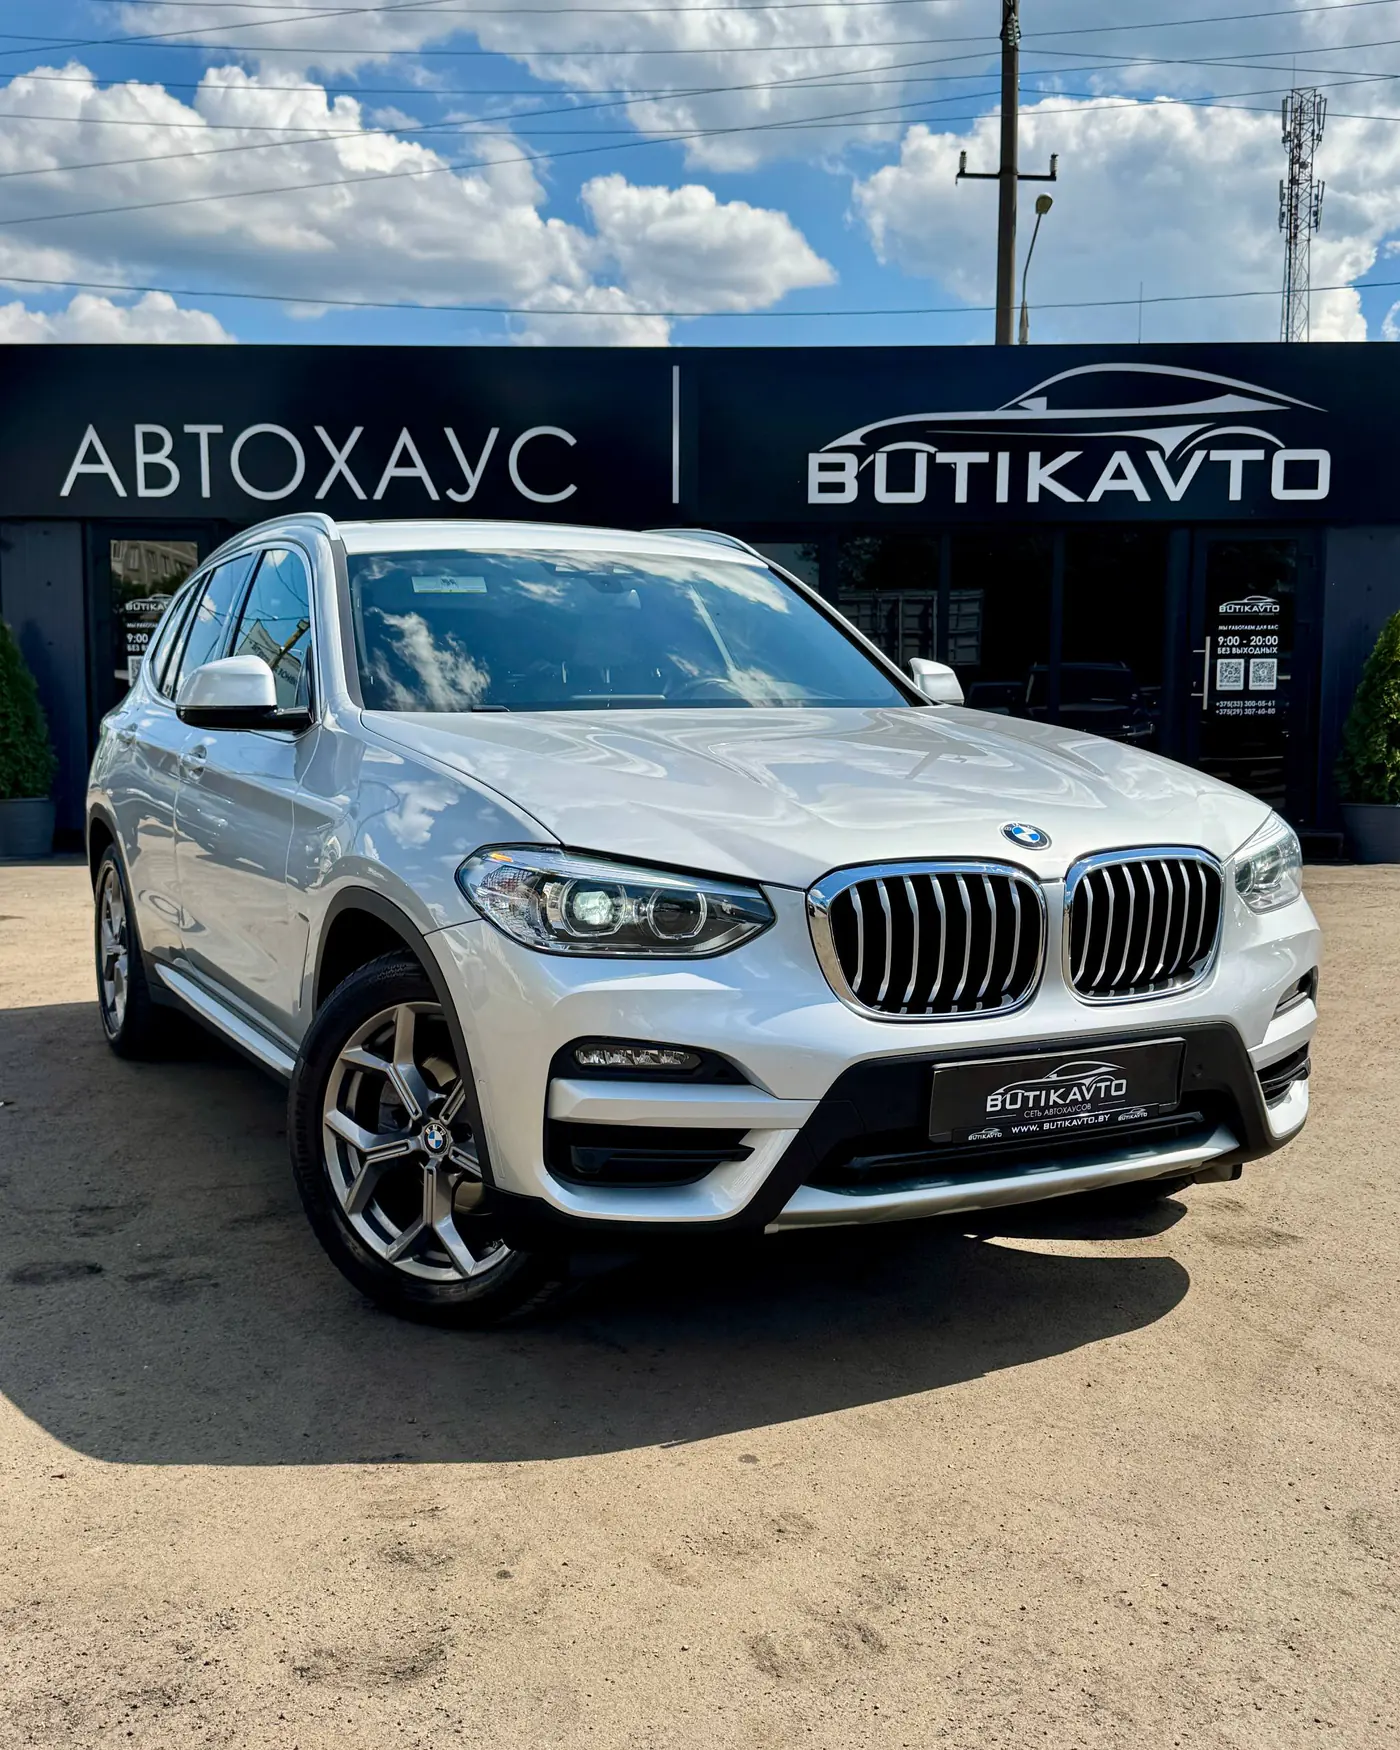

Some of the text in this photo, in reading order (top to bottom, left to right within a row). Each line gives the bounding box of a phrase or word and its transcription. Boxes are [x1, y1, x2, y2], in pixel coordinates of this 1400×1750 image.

[60, 423, 578, 503] АВТОХАУС
[808, 448, 1331, 504] BUTIKAVTO
[1219, 604, 1280, 613] BUTIKAVTO
[126, 633, 149, 643] 9:00
[1217, 636, 1240, 646] 9:00
[1250, 636, 1279, 646] 20:00
[1217, 647, 1278, 655] БЕЗ ВЫХОДНЫХ
[986, 1079, 1127, 1112] BUTIKAVTO
[1023, 1103, 1092, 1119] СЕТЬ АВТОХАУСОВ
[1011, 1114, 1111, 1134] WWW. BUTIKAVTO.BY
